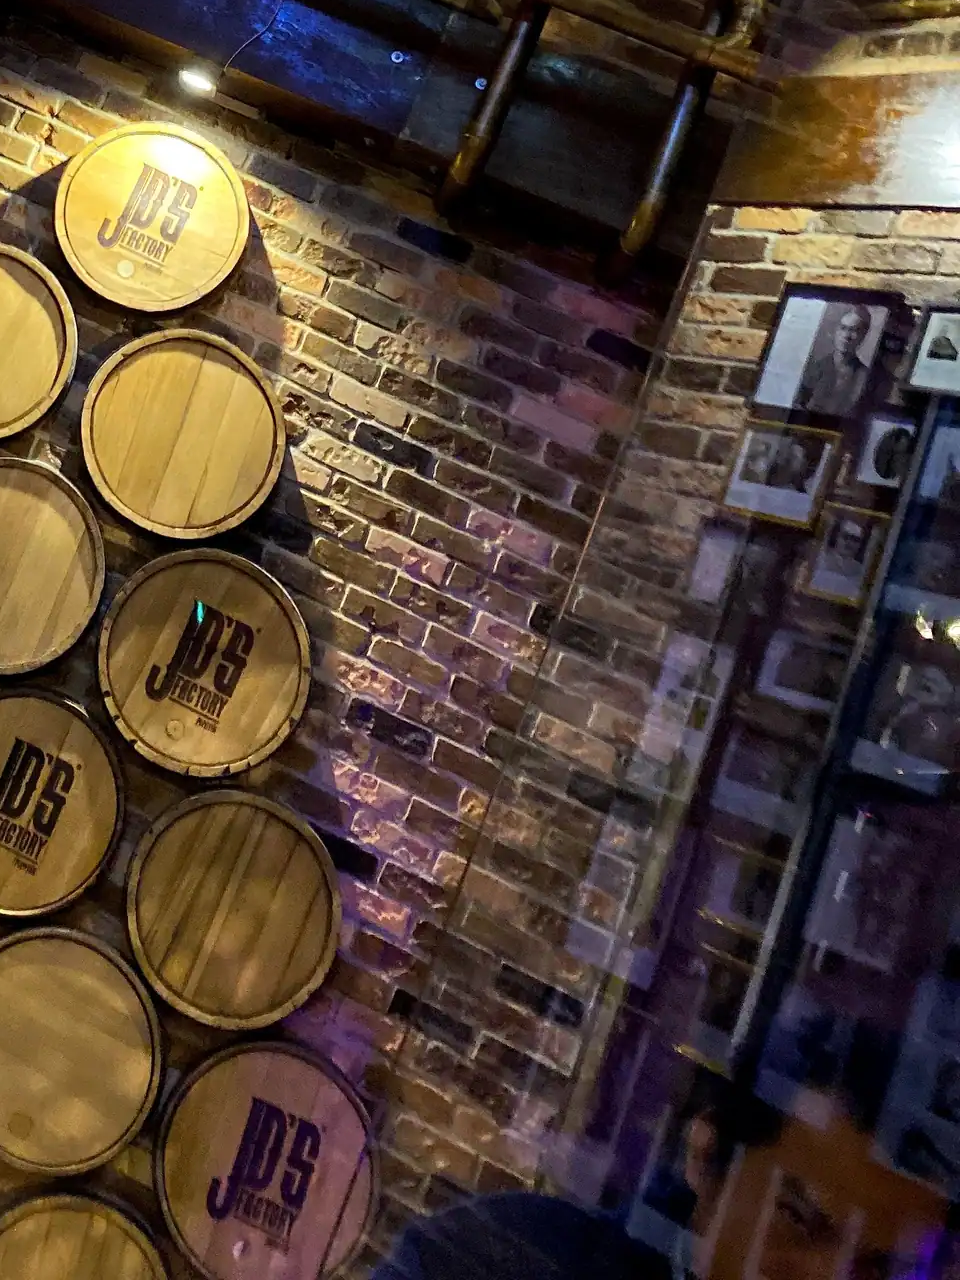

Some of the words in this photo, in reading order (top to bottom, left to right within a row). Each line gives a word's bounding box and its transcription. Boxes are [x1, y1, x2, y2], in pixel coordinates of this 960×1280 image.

[97, 162, 198, 249] JD'S
[120, 228, 174, 263] FACTORY
[145, 600, 255, 702] JD'S
[171, 675, 228, 718] FACTORY
[207, 1097, 322, 1221] JD'S
[233, 1191, 298, 1239] FACTORY
